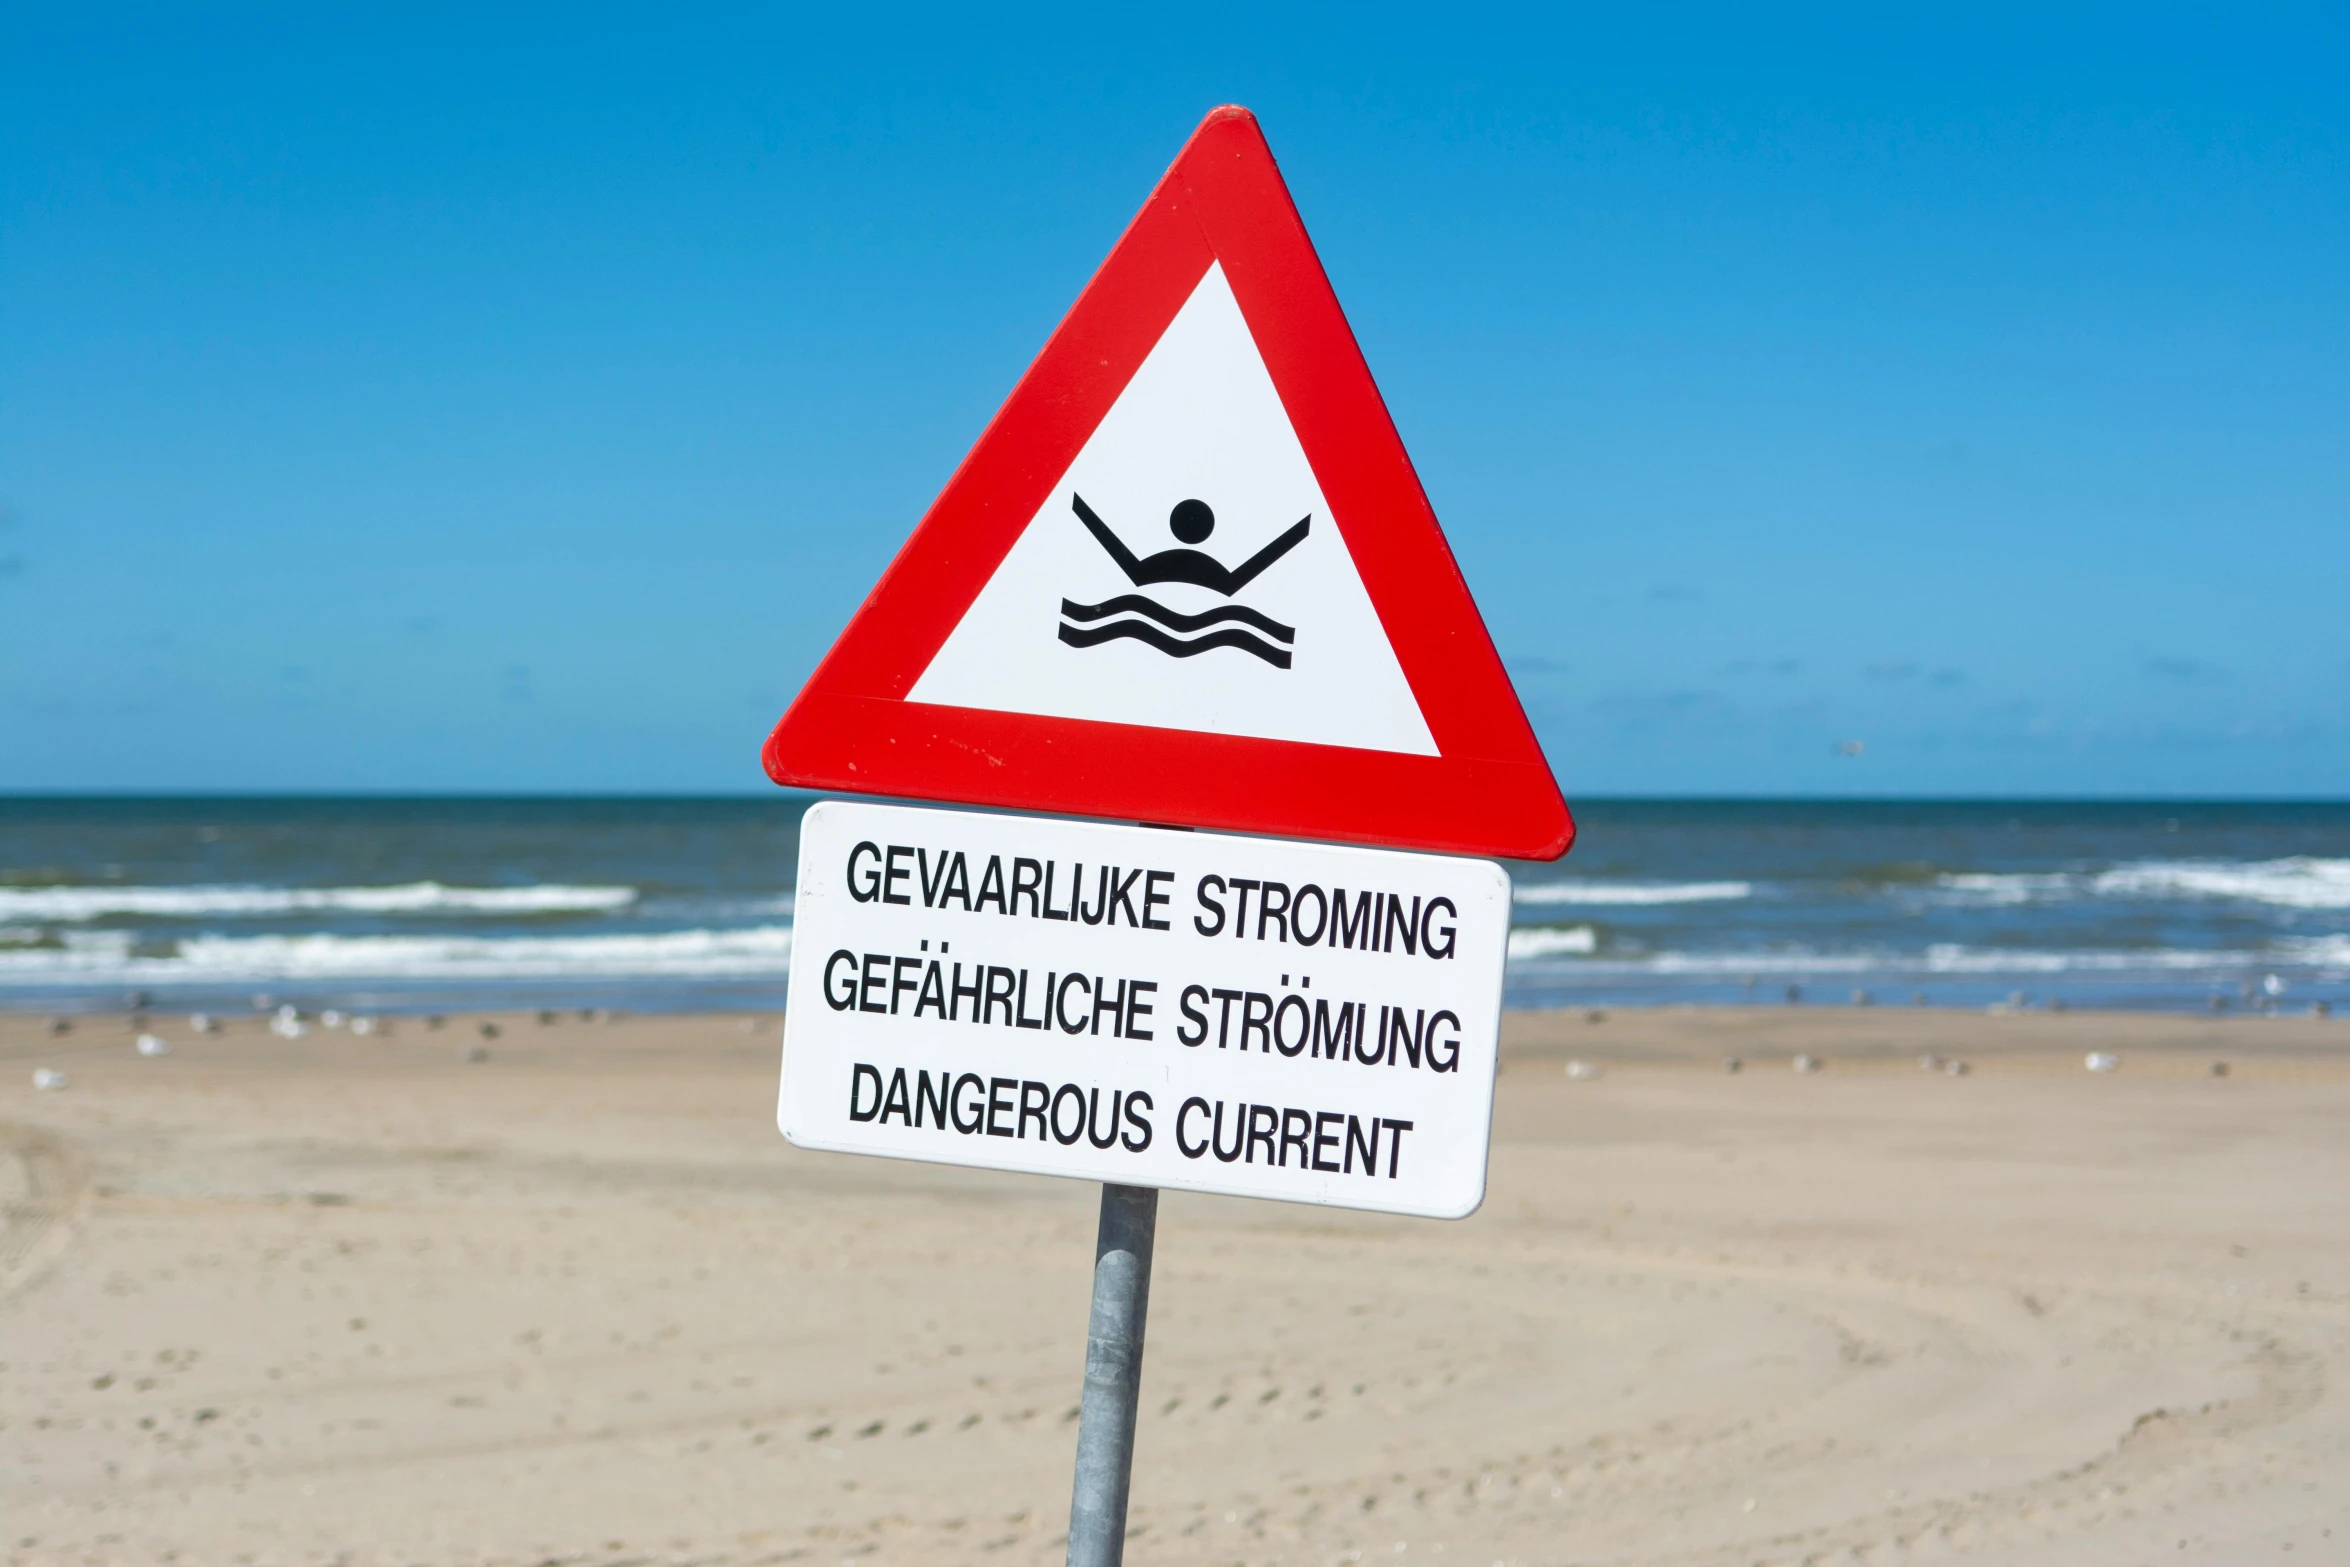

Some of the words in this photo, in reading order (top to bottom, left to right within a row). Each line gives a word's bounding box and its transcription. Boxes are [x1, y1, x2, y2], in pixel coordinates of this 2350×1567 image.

[847, 840, 1175, 931] GEVAARLIJKE
[1194, 874, 1458, 960] STROMING
[823, 939, 1158, 1041] GEFÄHRLICHE
[1177, 974, 1461, 1073] STRÖMUNG
[849, 1062, 1154, 1153] DANGEROUS
[1175, 1096, 1414, 1179] CURRENT
